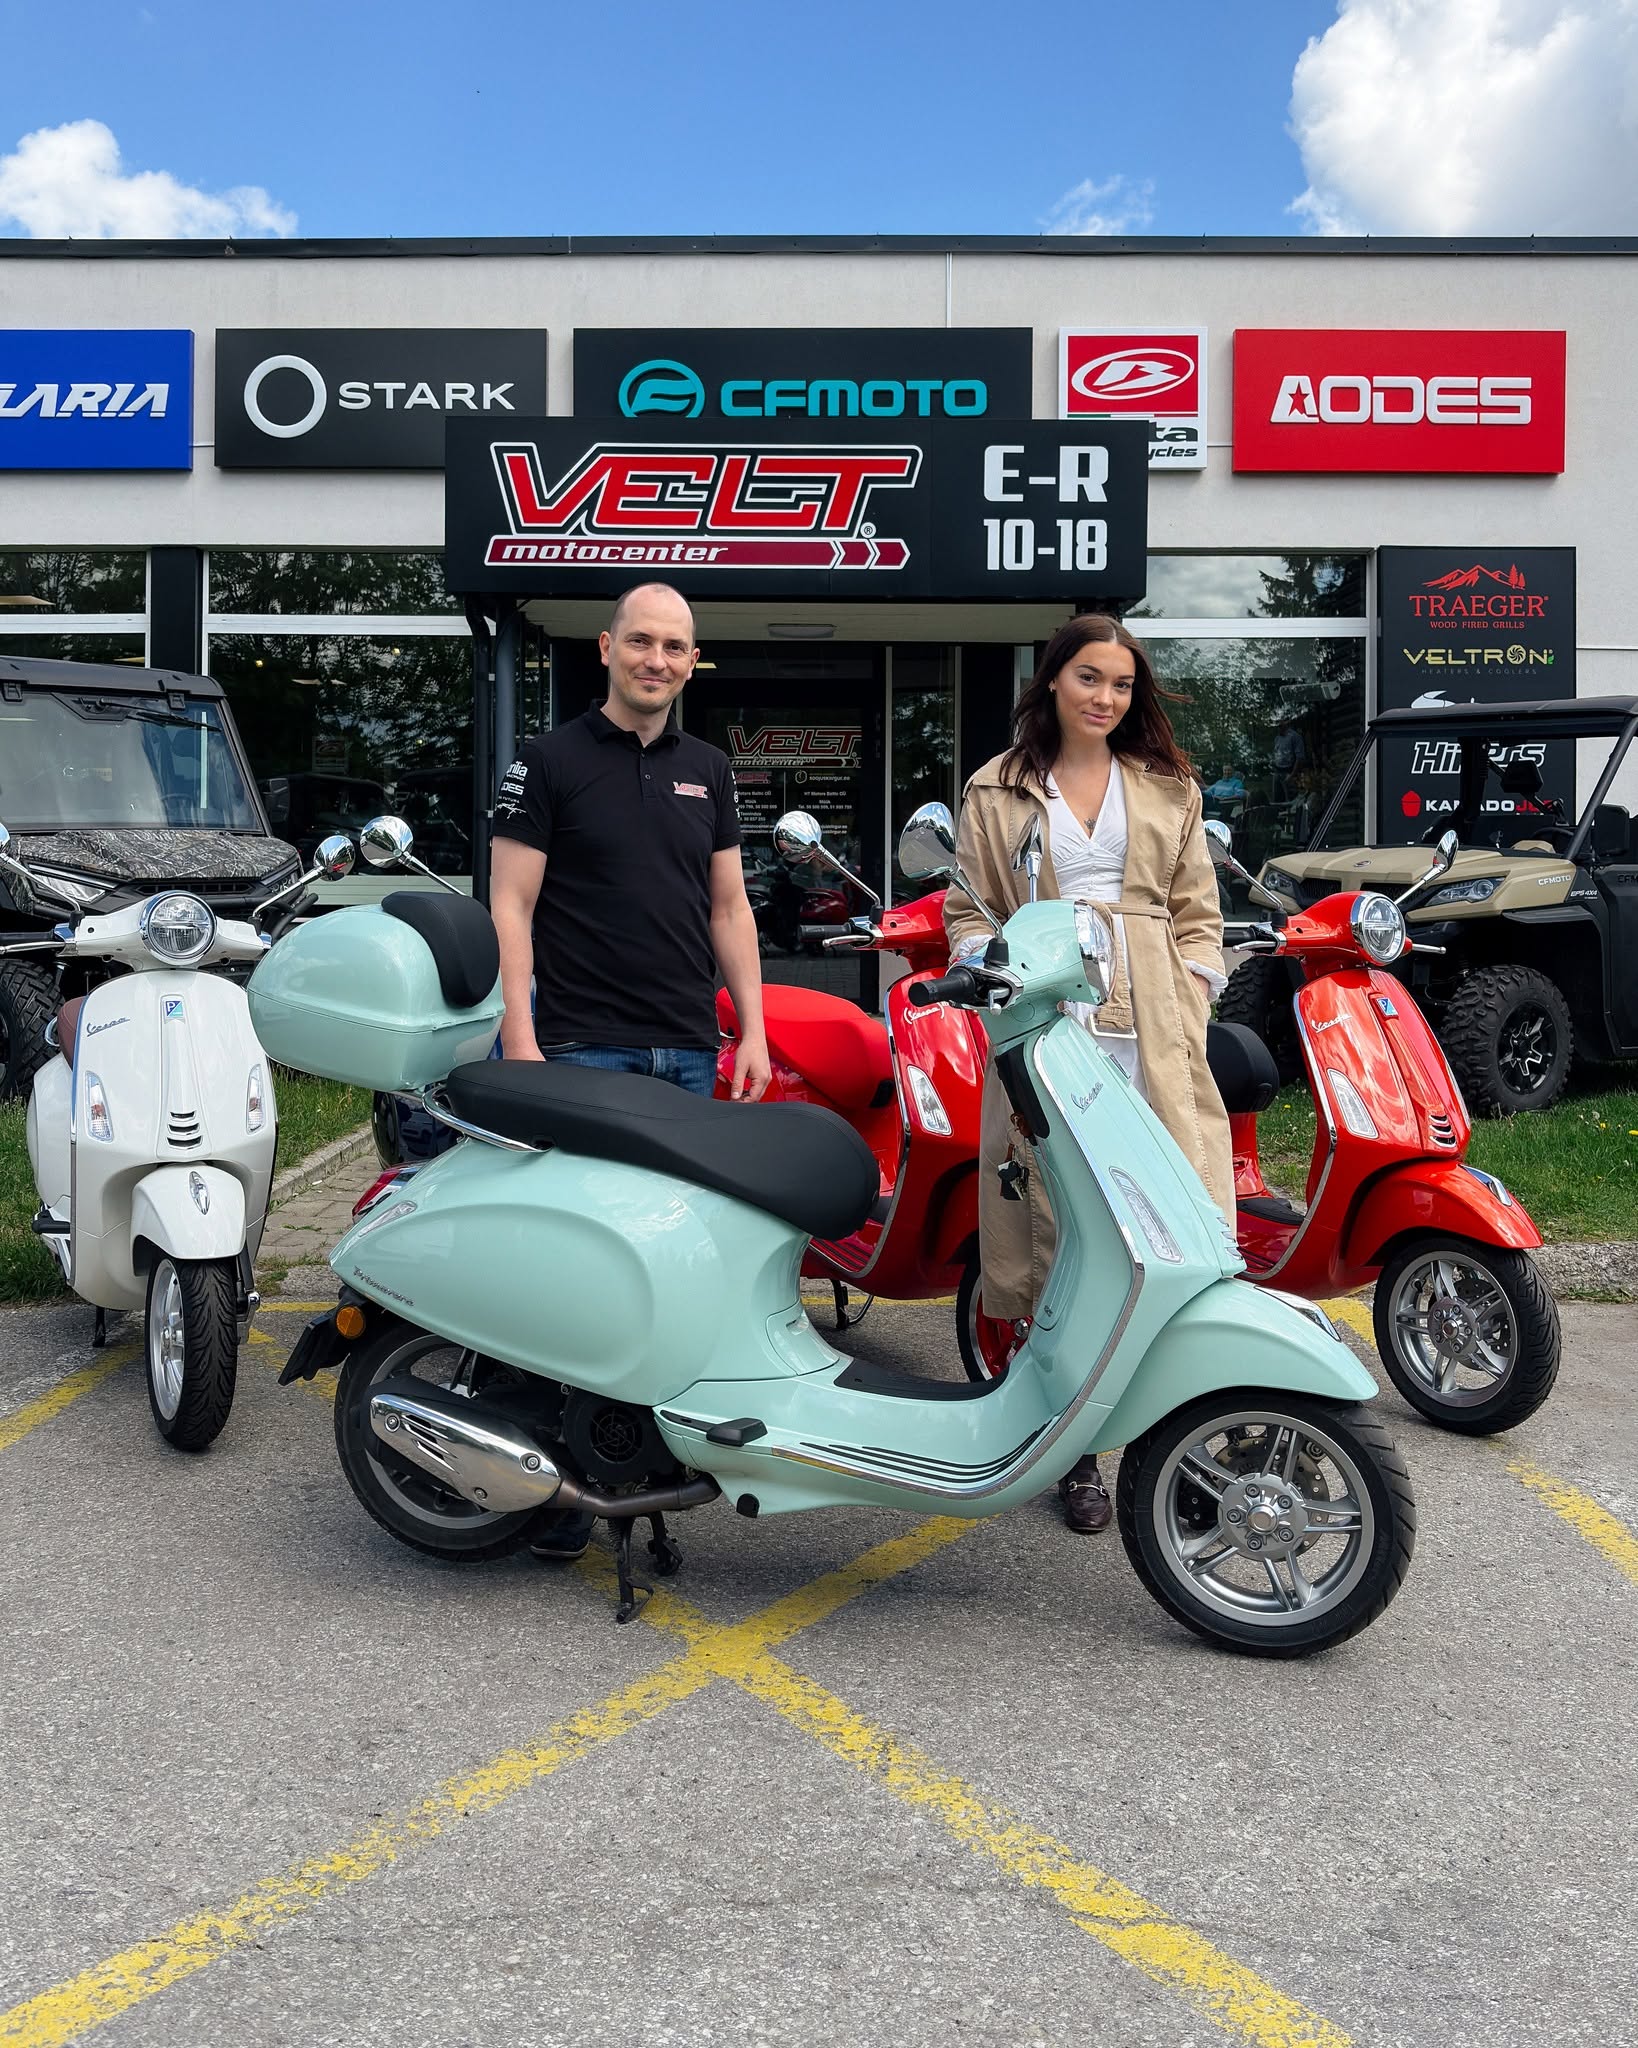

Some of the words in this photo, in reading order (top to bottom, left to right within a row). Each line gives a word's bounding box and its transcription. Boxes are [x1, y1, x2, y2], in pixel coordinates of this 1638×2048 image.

[338, 382, 516, 411] STARK
[720, 379, 988, 418] CFMOTO
[1269, 375, 1533, 425] AODES
[490, 442, 924, 538] VELT
[983, 445, 1109, 503] E-R
[501, 540, 729, 563] motocenter
[983, 518, 1108, 571] 10-18
[1408, 594, 1547, 618] TRAEGER
[1429, 620, 1458, 630] WOOD
[1461, 620, 1489, 630] FIRED
[1492, 620, 1526, 630] GRILLS
[1538, 874, 1572, 886] CFMOTO
